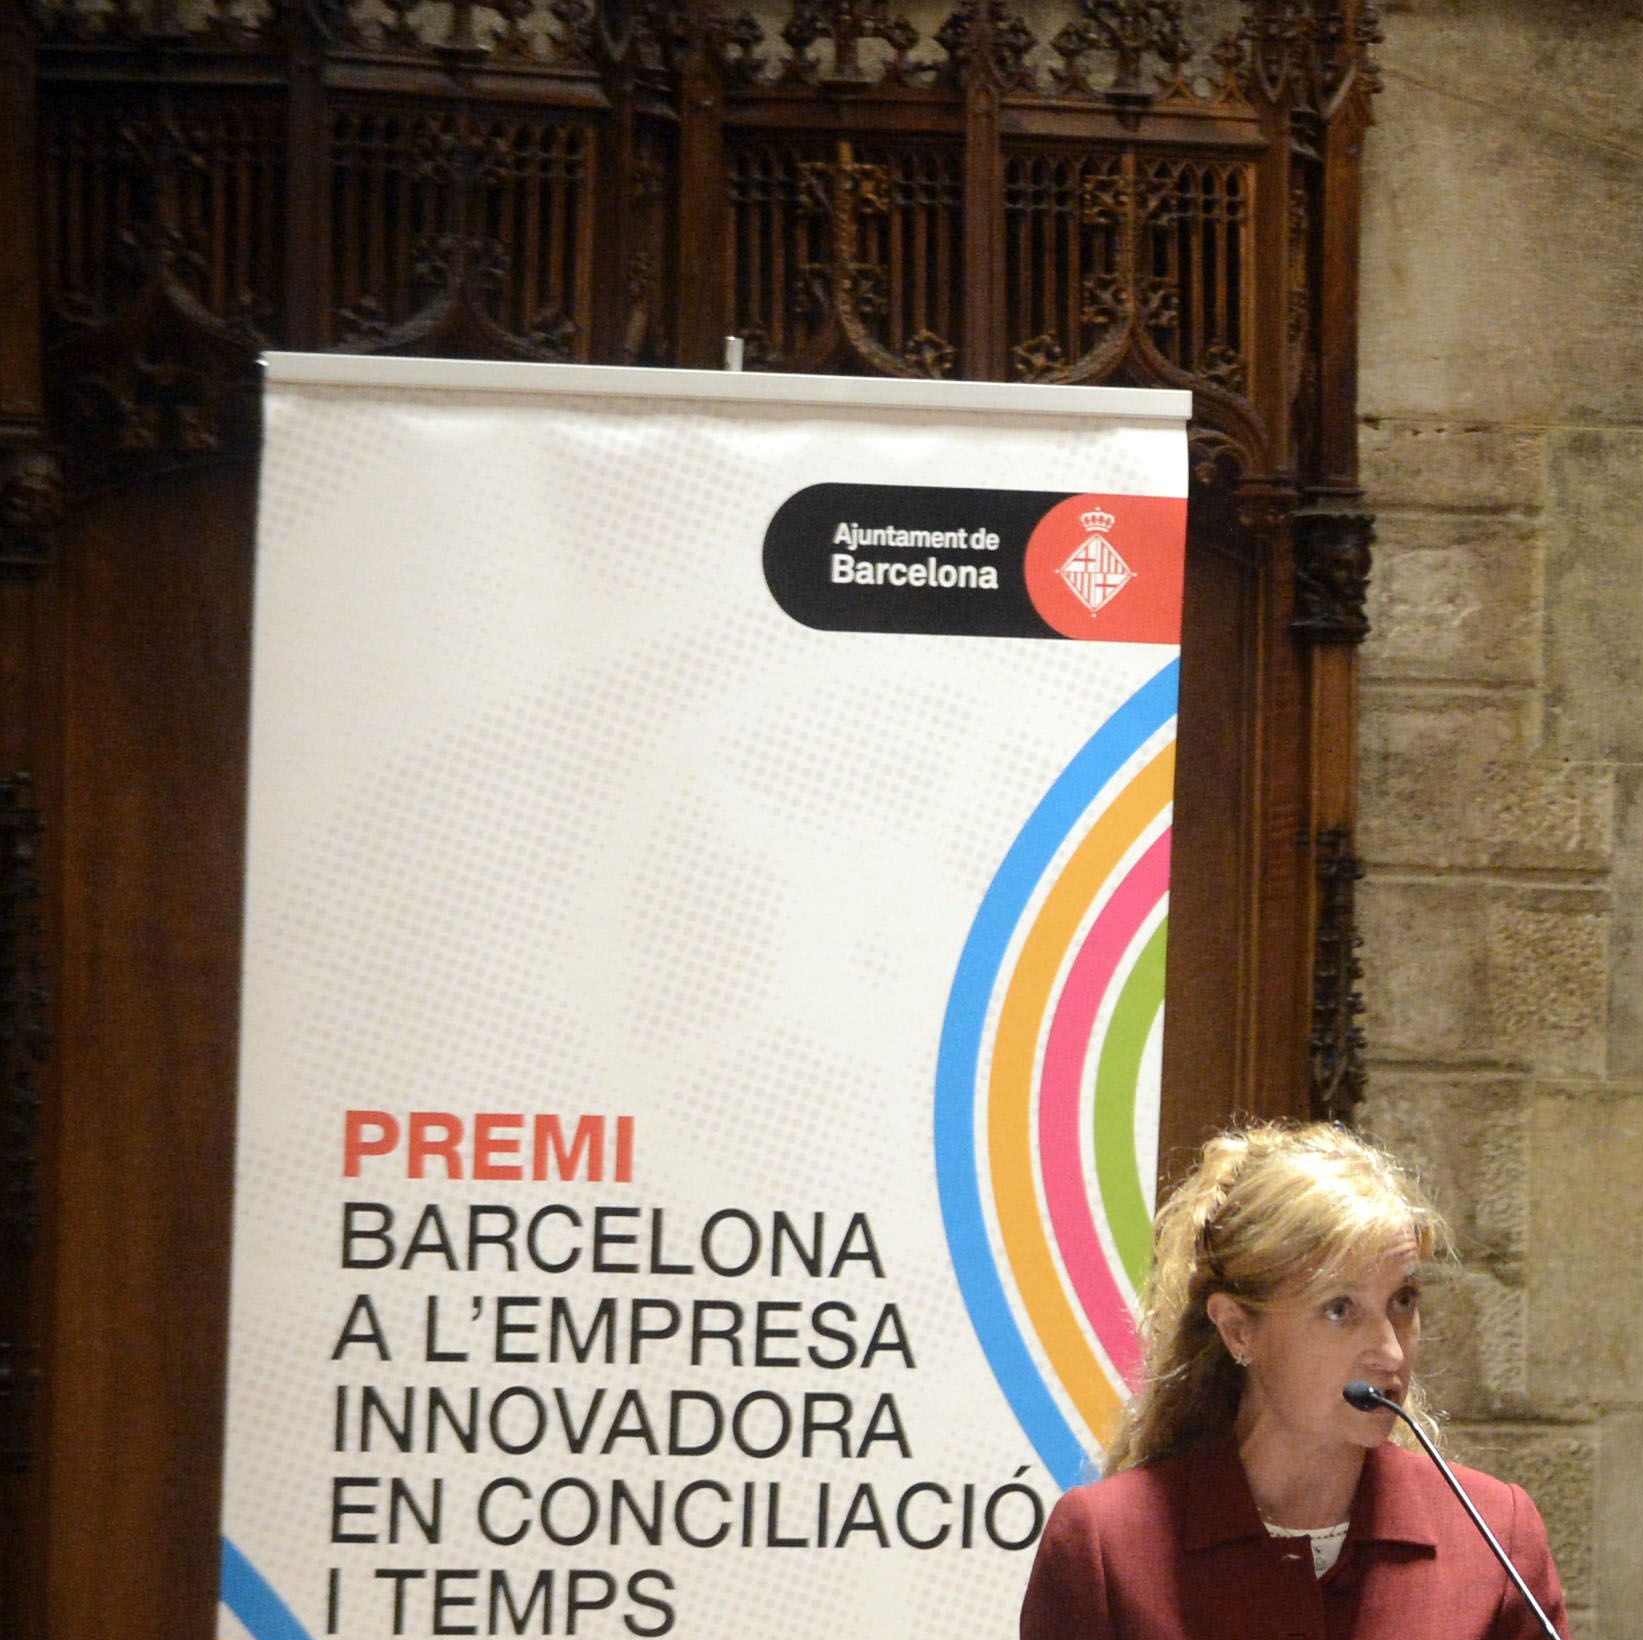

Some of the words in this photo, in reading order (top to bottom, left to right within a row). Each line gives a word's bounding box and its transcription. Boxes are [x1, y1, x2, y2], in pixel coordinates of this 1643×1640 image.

[831, 553, 999, 590] Barcelona
[833, 522, 968, 551] Ajuntament
[969, 527, 1000, 551] de
[342, 1109, 635, 1184] PREMI
[341, 1201, 885, 1278] BARCELONA
[331, 1294, 391, 1361] A
[425, 1295, 916, 1370] L’EMPRESA
[333, 1385, 911, 1459] INNOVADORA
[330, 1476, 442, 1545] EN
[477, 1465, 1044, 1551] CONCILIACIÓ
[326, 1567, 340, 1635] I
[374, 1568, 676, 1638] TEMPS
